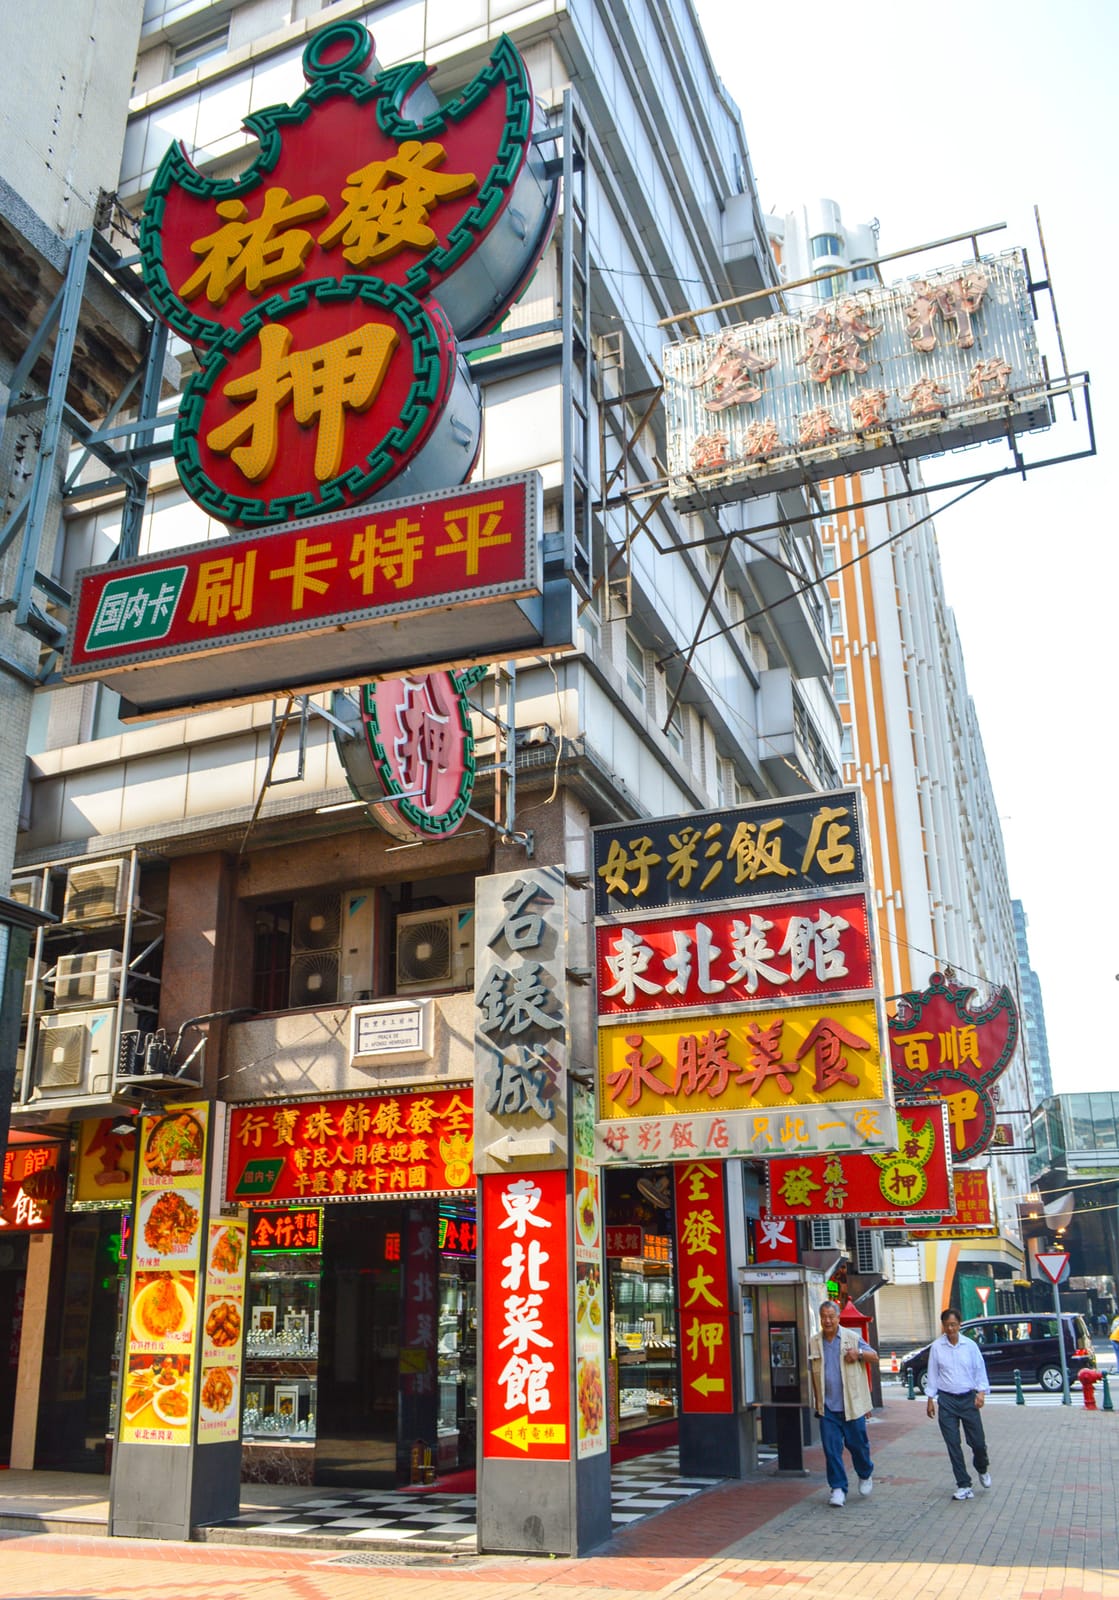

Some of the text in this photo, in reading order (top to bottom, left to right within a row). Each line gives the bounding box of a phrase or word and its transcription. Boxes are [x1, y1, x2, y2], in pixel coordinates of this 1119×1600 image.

[179, 141, 479, 304] 祐發
[207, 323, 400, 483] 押
[188, 500, 512, 626] 刷卡特平
[94, 584, 176, 635] 国内卡
[599, 806, 856, 897] 好彩飯店
[602, 909, 851, 1005] 東北菜館
[607, 1017, 870, 1106] 永勝美食
[893, 1024, 982, 1072] 百順
[603, 1107, 883, 1153] 好彩飯店 只此一家
[778, 1166, 822, 1207] 發
[888, 1167, 918, 1199] 押
[250, 1216, 296, 1247] 金行
[293, 1230, 317, 1246] 公司
[679, 1163, 724, 1365] 全發大押
[498, 1179, 555, 1415] 東北菜館
